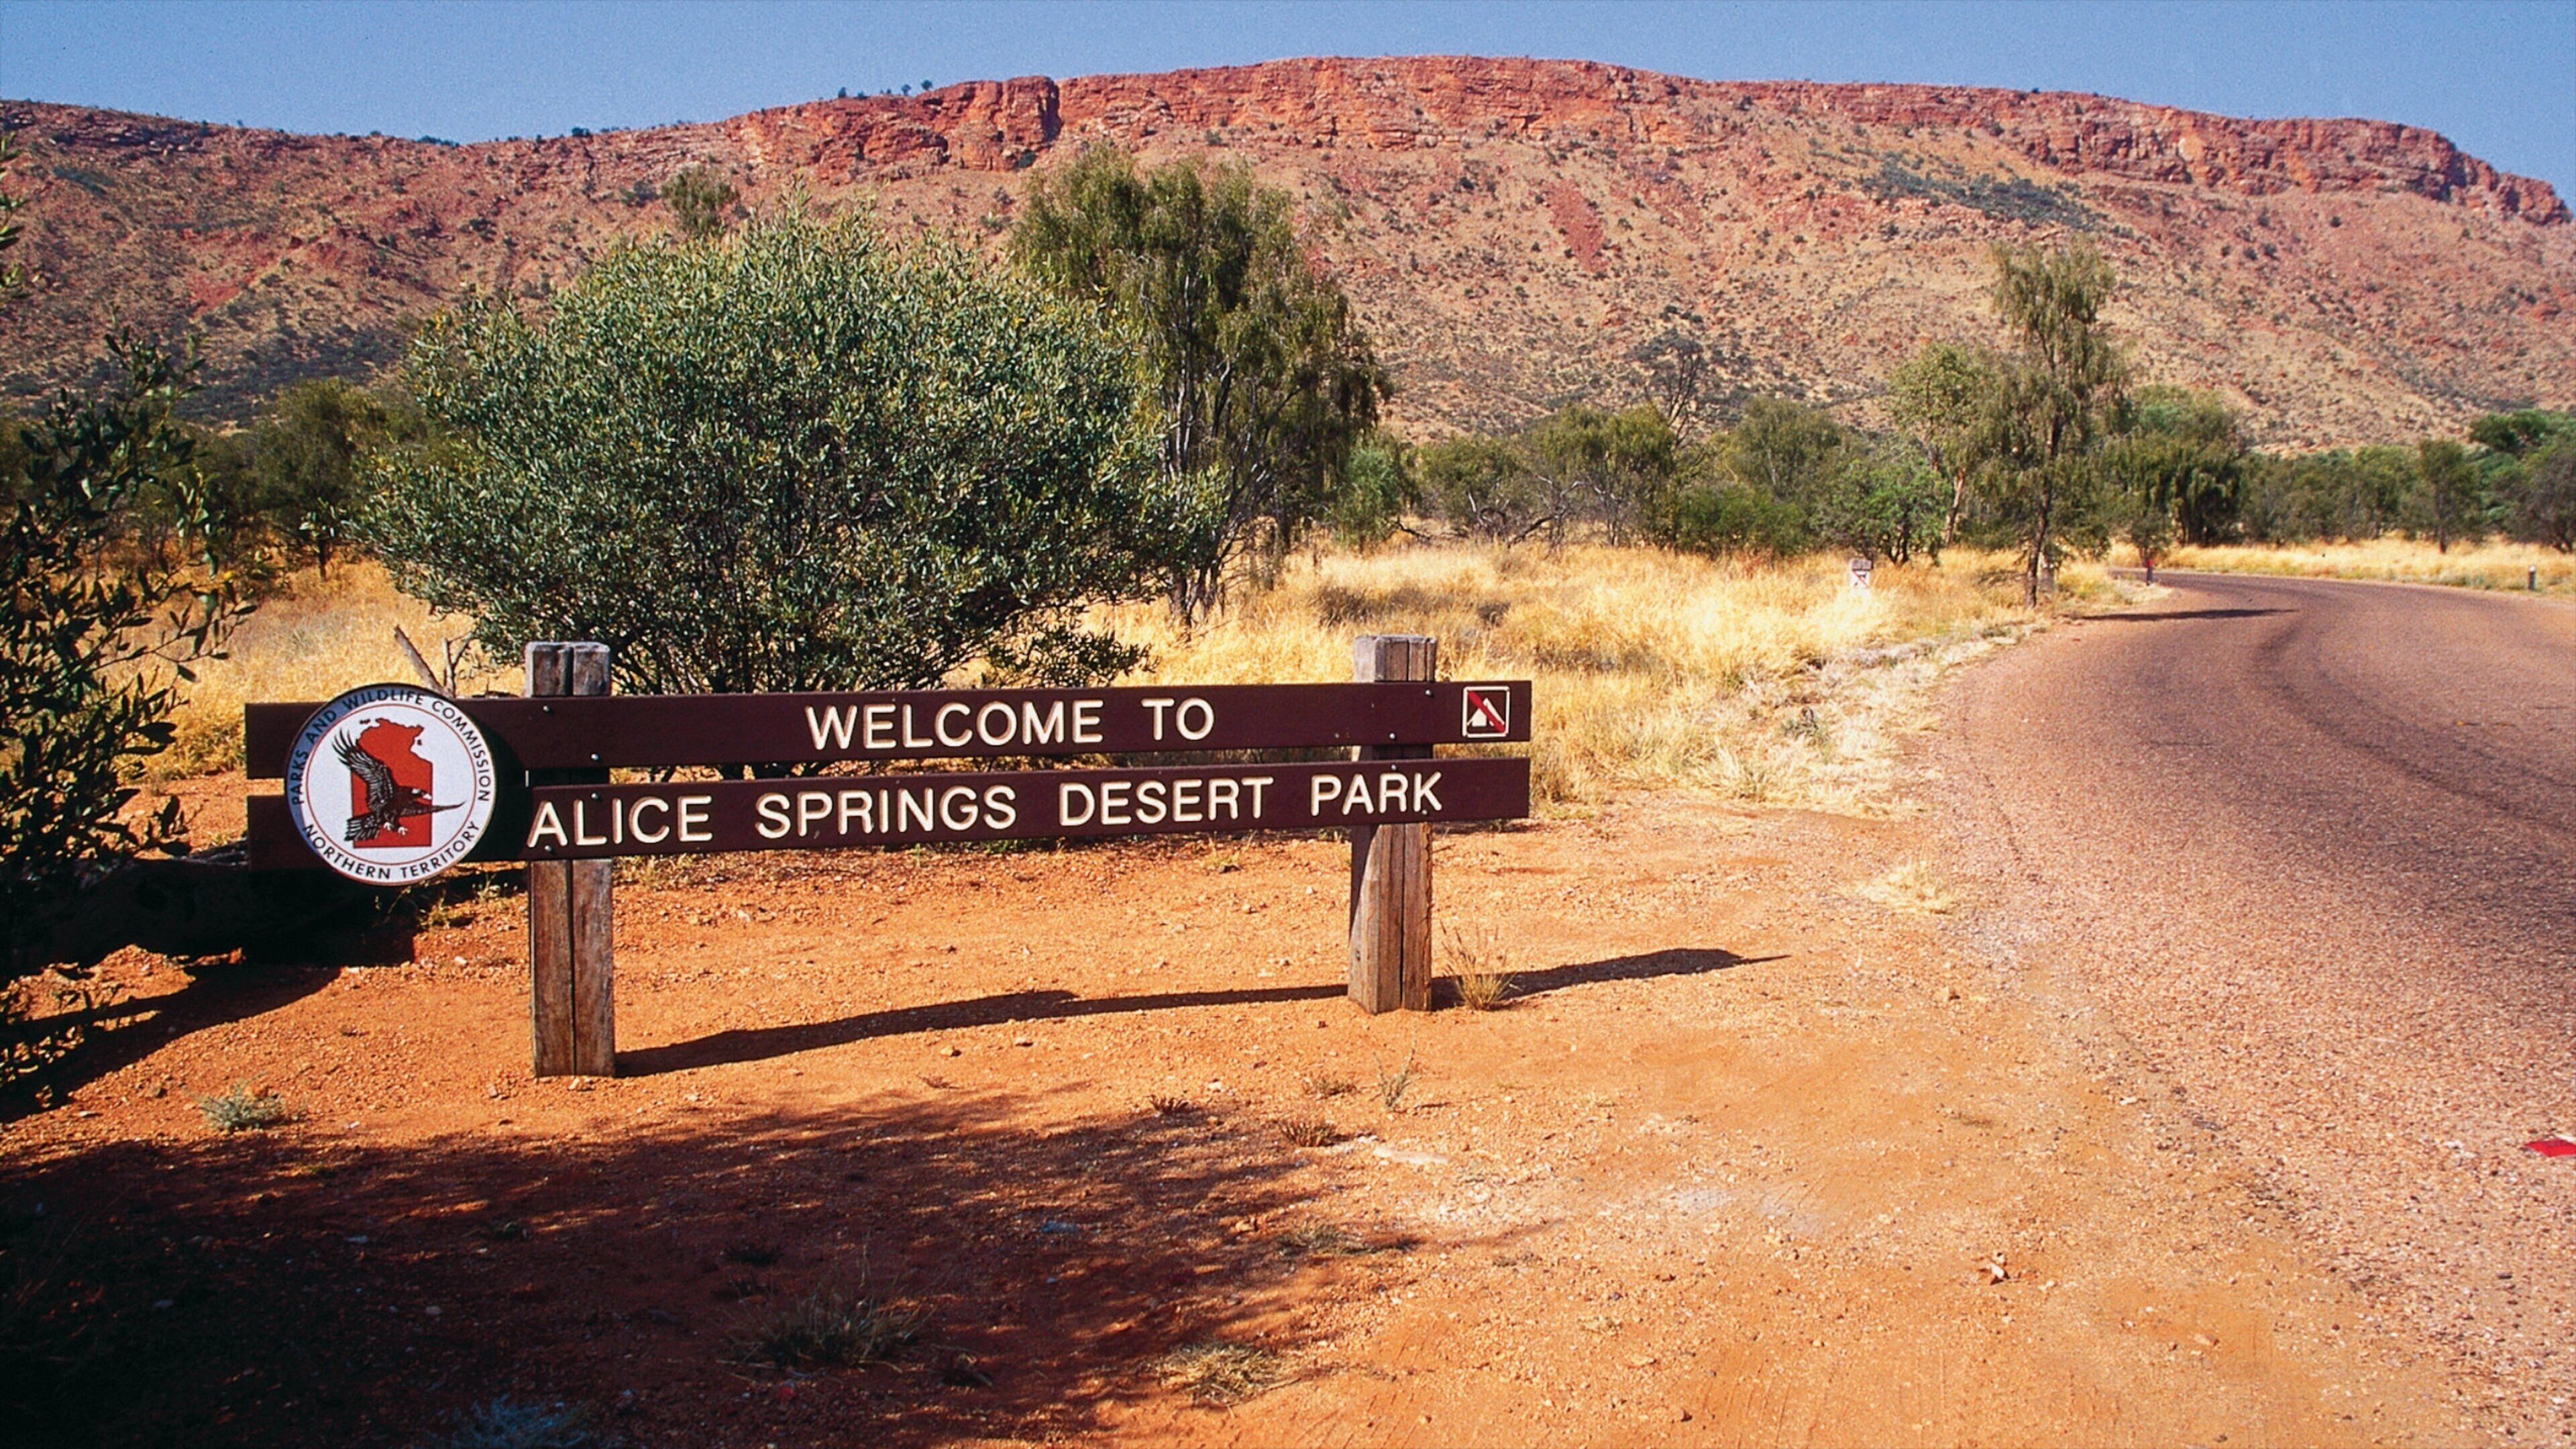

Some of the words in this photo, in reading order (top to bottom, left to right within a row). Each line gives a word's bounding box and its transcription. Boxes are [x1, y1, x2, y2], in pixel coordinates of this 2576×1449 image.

[290, 749, 309, 806] PARKS
[305, 710, 337, 744] AND
[342, 688, 424, 710] WILDLIFE
[432, 700, 491, 802] COMMISSION
[804, 700, 1104, 751] WELCOME
[1140, 697, 1215, 741] TO
[527, 795, 713, 849] ALICE
[756, 784, 1017, 839] SPRINGS
[1059, 776, 1275, 827] DESERT
[1310, 771, 1443, 816] PARK
[303, 824, 391, 879] NORTHERN
[400, 821, 479, 879] TERRITORY
